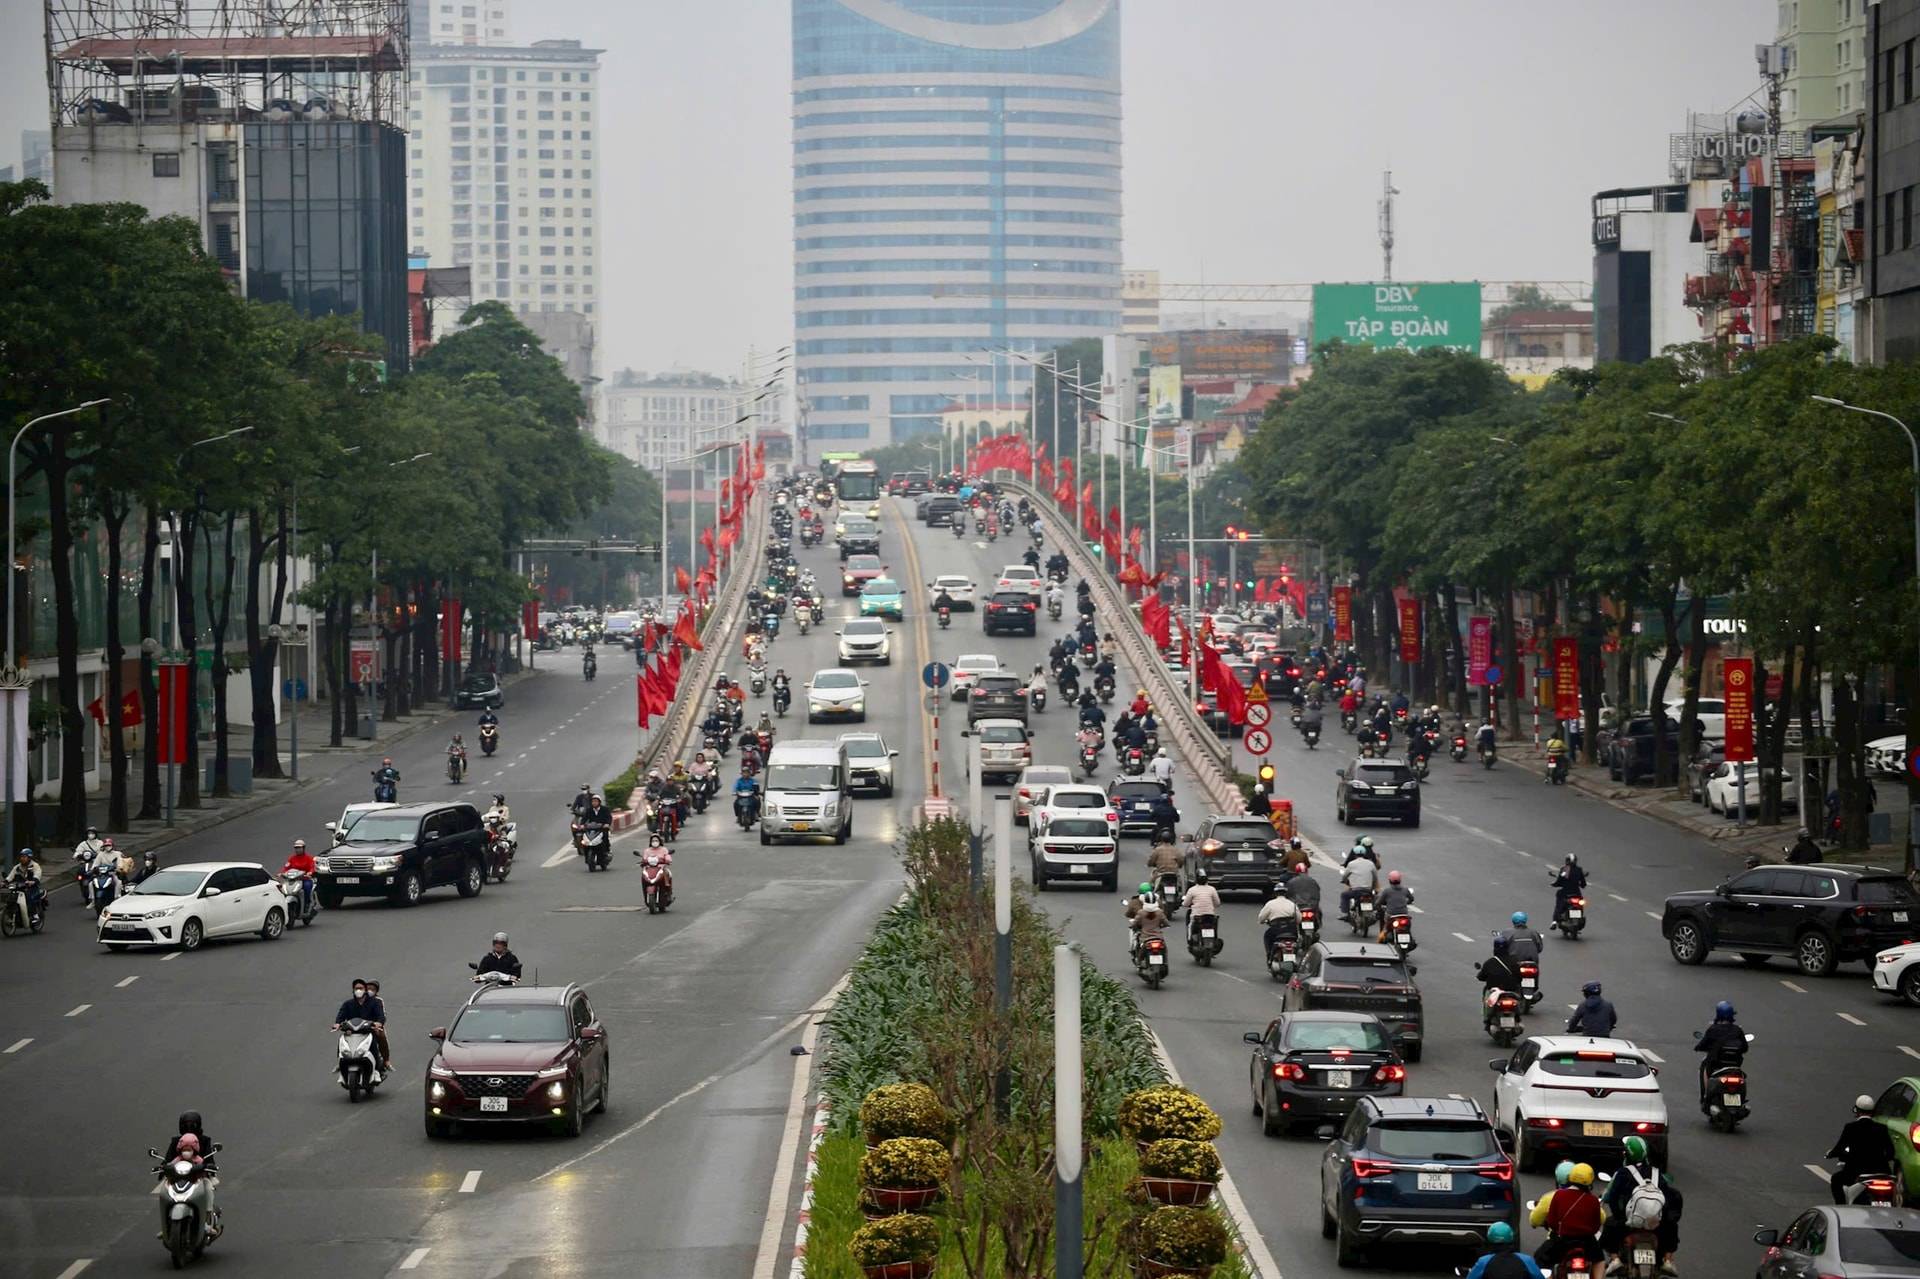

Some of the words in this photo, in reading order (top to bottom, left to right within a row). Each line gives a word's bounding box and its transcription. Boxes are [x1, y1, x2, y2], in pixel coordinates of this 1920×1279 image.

[1731, 132, 1805, 157] HOTEL
[1375, 286, 1420, 303] DBV
[1375, 304, 1419, 313] Insurance
[1345, 315, 1384, 341] TẬP
[1390, 315, 1448, 337] ĐOÀN
